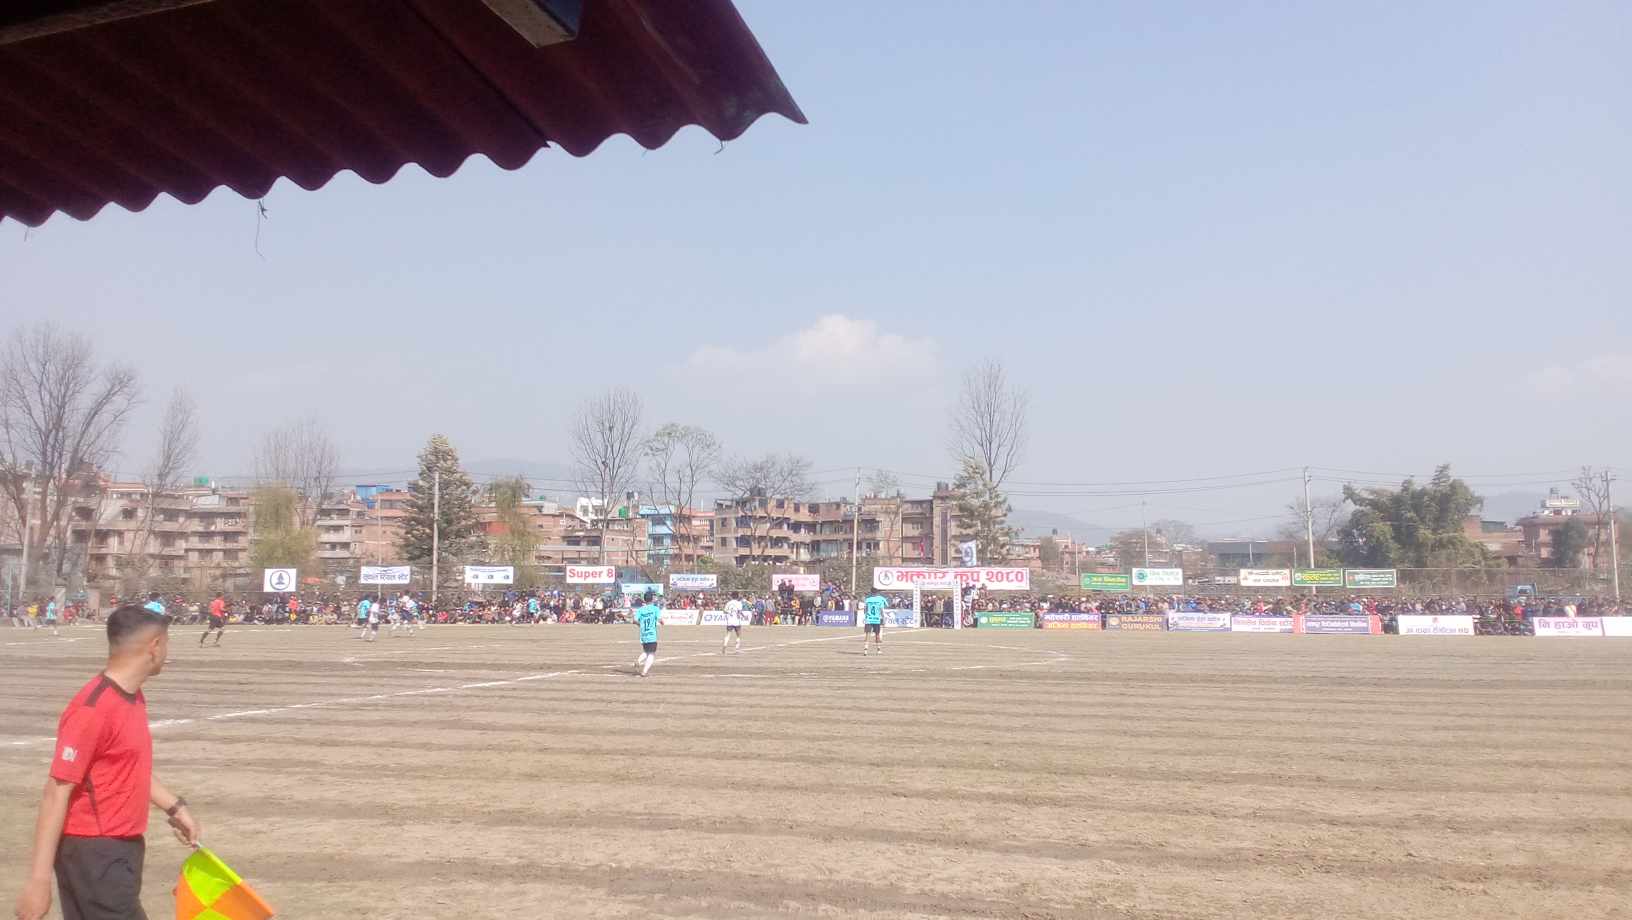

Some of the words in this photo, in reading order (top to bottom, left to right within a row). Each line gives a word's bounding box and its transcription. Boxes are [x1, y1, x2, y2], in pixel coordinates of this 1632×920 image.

[568, 568, 604, 580] Super
[607, 568, 615, 578] 8
[986, 570, 1025, 583] २०८०
